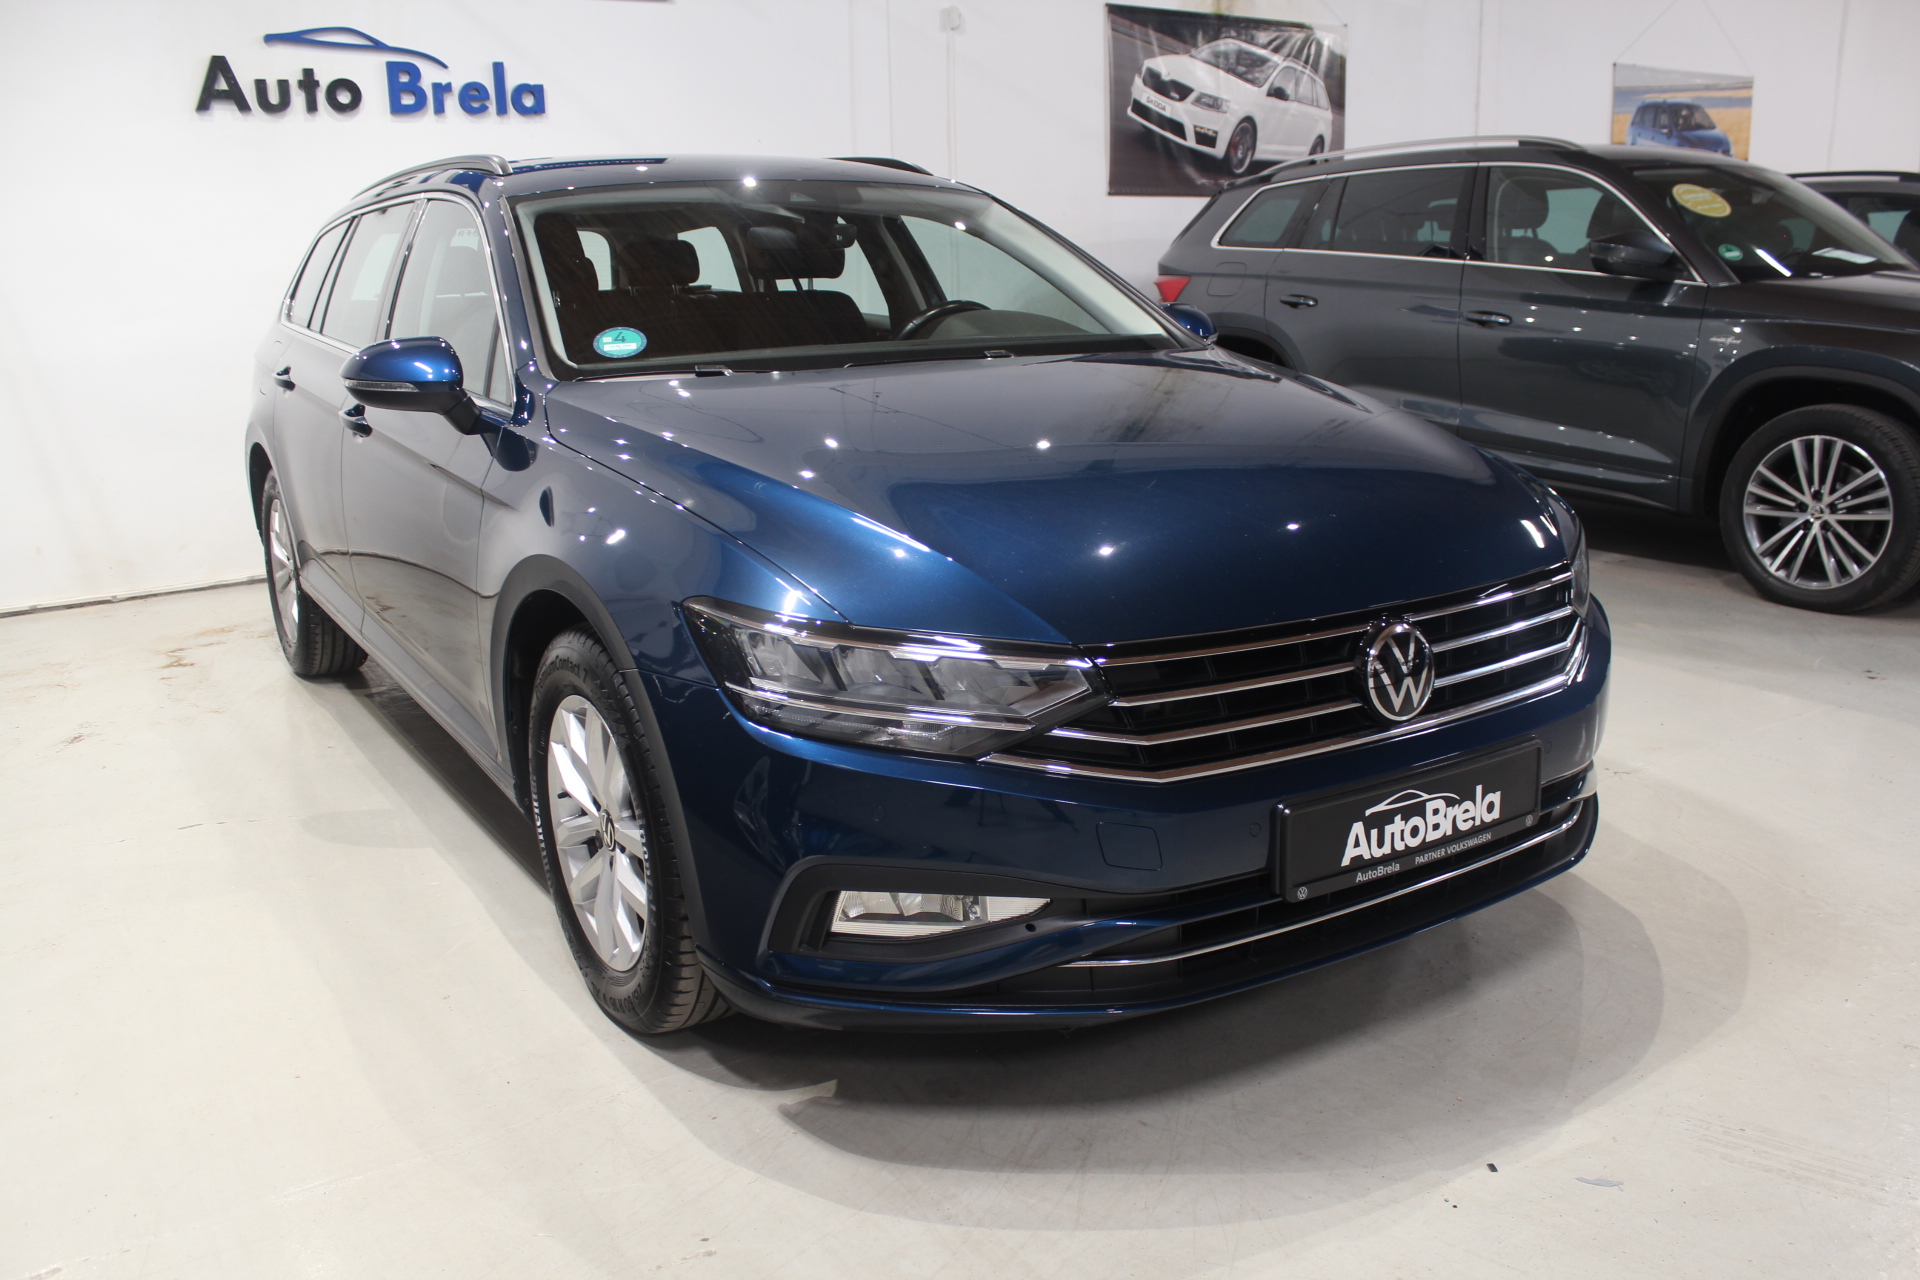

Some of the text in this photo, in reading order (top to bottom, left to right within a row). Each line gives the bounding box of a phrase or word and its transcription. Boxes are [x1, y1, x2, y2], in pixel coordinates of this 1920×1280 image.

[195, 55, 547, 115] Auto Brela
[613, 331, 627, 343] 4
[1340, 785, 1501, 867] AutoBrela
[1414, 832, 1492, 865] PARTNER VOLKSWAGEN
[1356, 862, 1400, 883] AutoBrela
